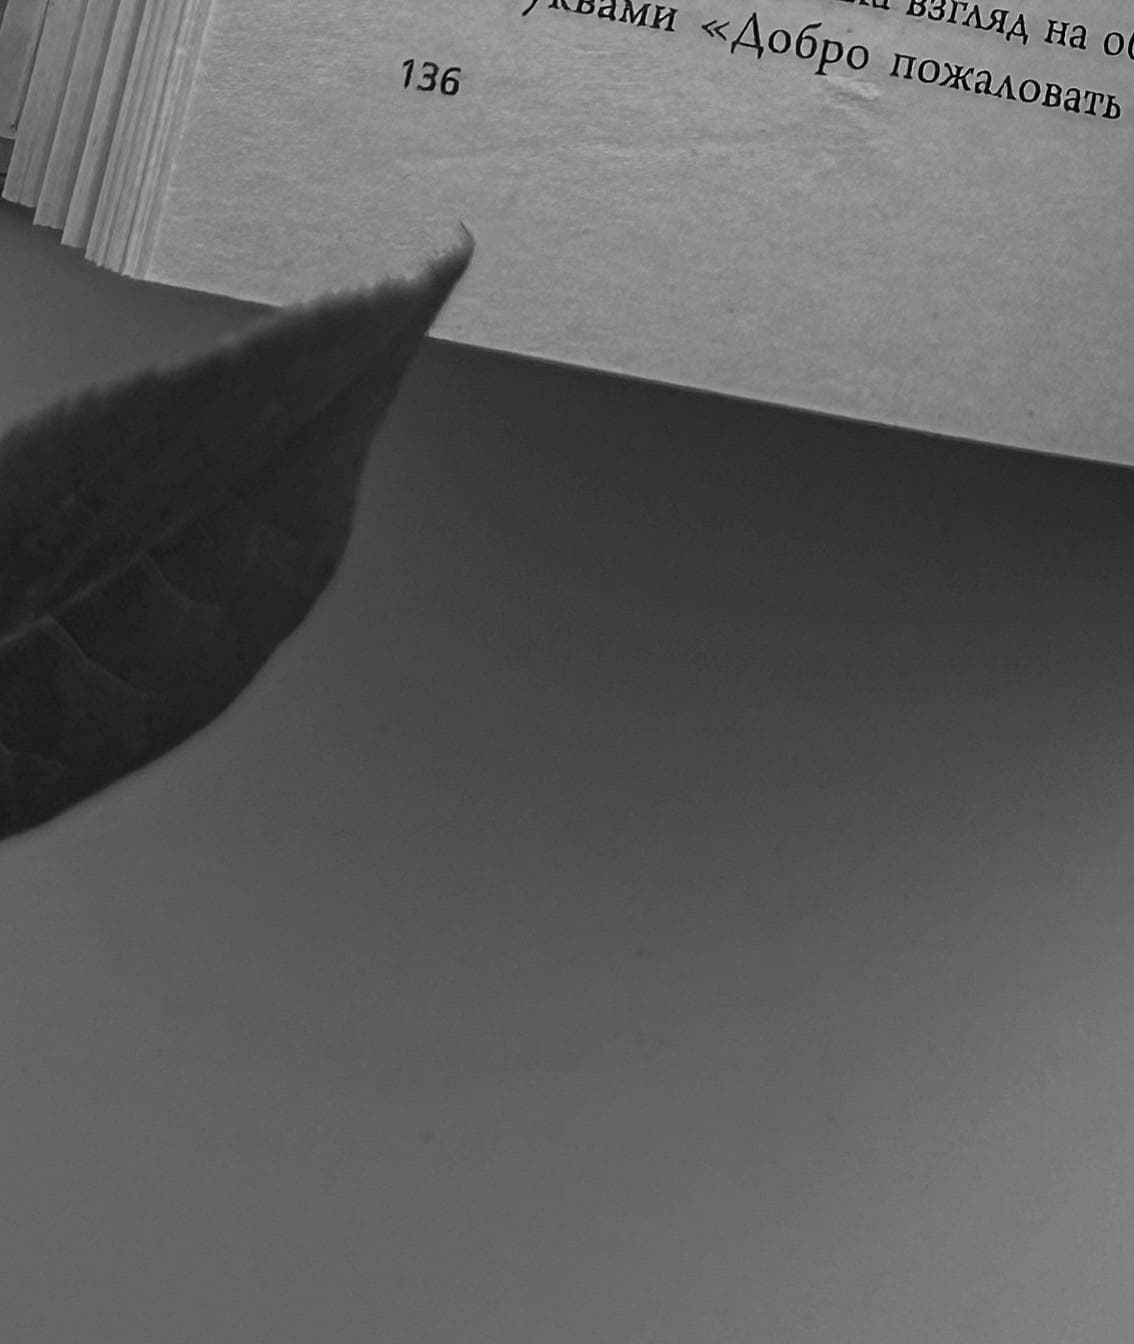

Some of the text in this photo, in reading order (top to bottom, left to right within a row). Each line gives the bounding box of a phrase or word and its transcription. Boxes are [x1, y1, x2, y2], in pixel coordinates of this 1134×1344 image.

[1043, 18, 1087, 51] на
[402, 58, 462, 97] 136
[700, 11, 870, 77] «Добро
[888, 52, 1121, 120] пожаловать
